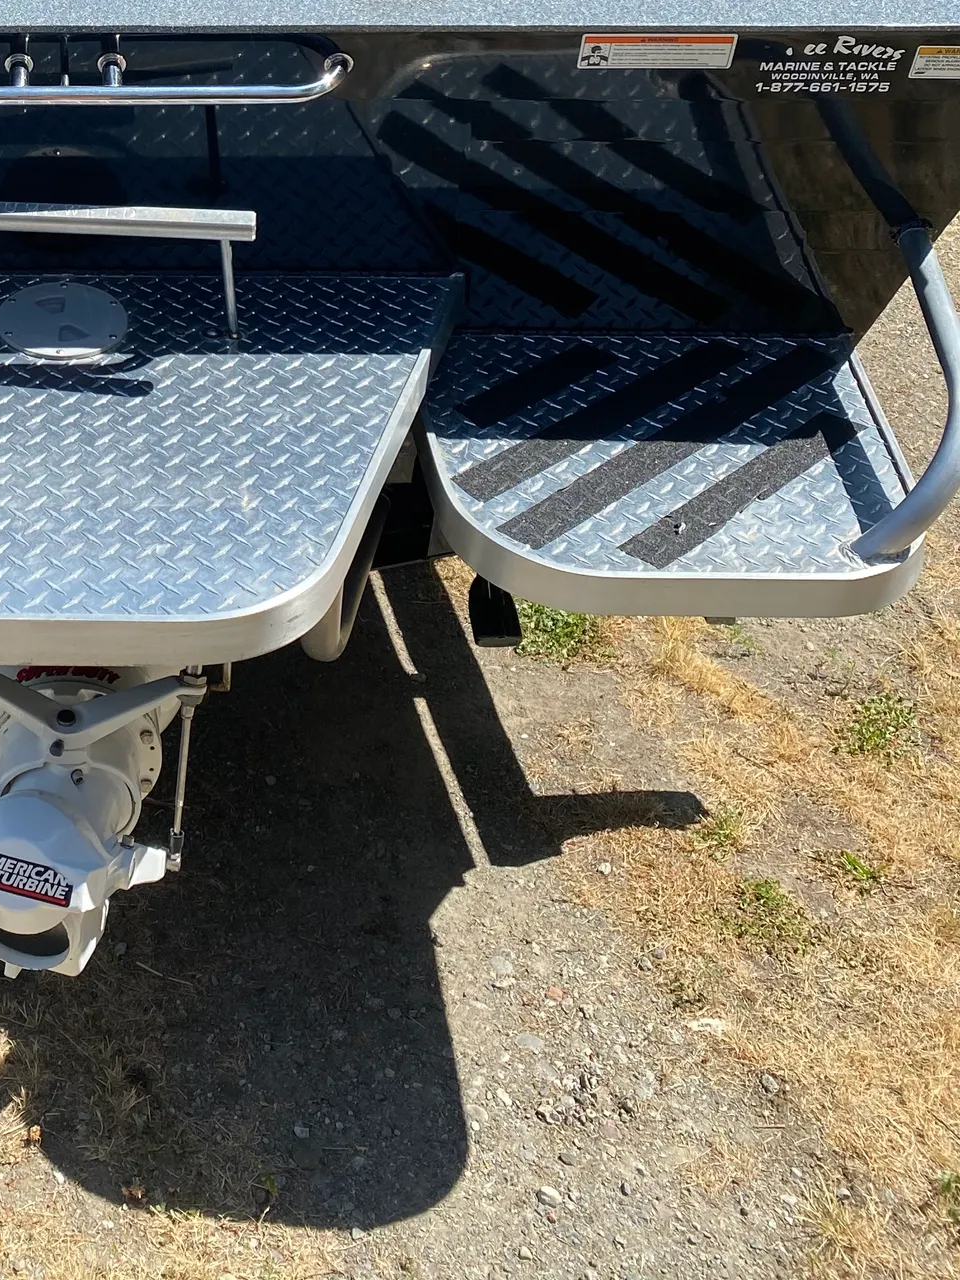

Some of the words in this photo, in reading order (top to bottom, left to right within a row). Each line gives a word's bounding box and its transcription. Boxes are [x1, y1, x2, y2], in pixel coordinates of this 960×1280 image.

[759, 62, 821, 71] MARINE
[823, 62, 834, 71] &
[838, 62, 897, 71] TACKLE
[771, 73, 857, 81] WOODINVILLE,
[755, 82, 890, 92] 1-877-661-1575
